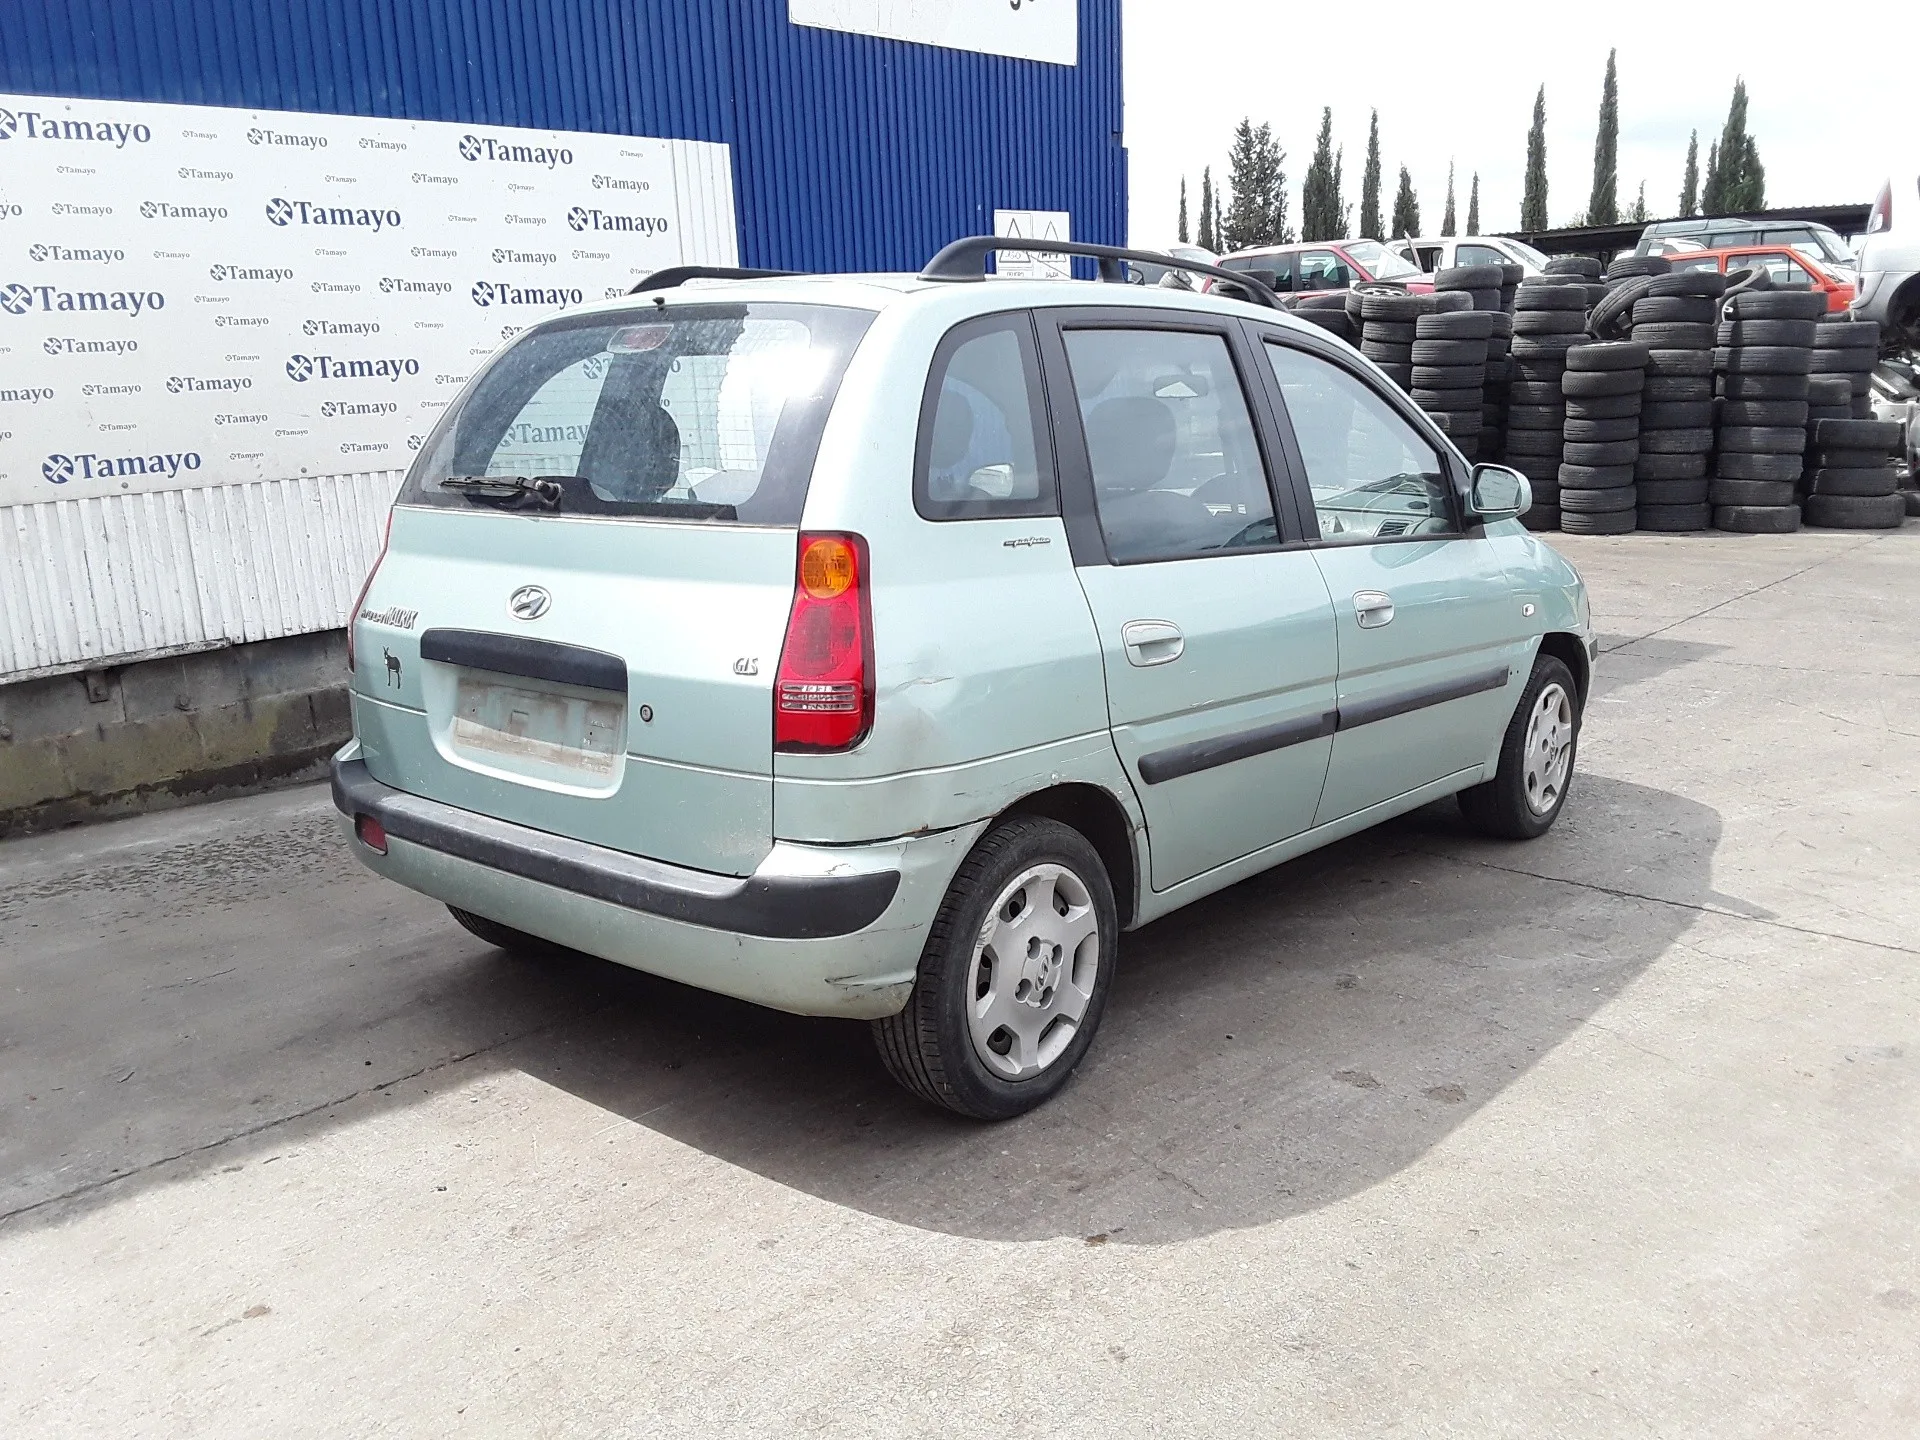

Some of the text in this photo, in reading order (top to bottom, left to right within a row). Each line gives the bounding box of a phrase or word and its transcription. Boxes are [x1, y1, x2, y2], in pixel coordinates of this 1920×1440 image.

[18, 112, 150, 149] Tamayo
[189, 131, 217, 140] Tamayo
[263, 130, 327, 150] Tamayo
[368, 140, 406, 152] Tamayo
[482, 138, 572, 169] Tamayo
[189, 169, 233, 180] Tamayo
[421, 174, 458, 186] Tamayo
[603, 177, 649, 193] Tamayo
[64, 205, 112, 217] Tamayo
[158, 203, 227, 222] Tamayo
[294, 201, 400, 233] Tamayo
[513, 215, 546, 227] Tamayo
[589, 209, 667, 238] Tamayo
[49, 246, 124, 264] Tamayo
[421, 249, 457, 260] Tamayo
[505, 249, 556, 267] Tamayo
[580, 252, 609, 261] Tamayo
[227, 265, 293, 283] Tamayo
[321, 283, 360, 295] Tamayo
[394, 278, 451, 296] Tamayo
[34, 286, 164, 318] Tamayo
[202, 296, 229, 304] Tamayo
[495, 283, 582, 310] Tamayo
[226, 317, 269, 329] Tamayo
[318, 320, 379, 337] Tamayo
[62, 338, 137, 356] Tamayo
[314, 355, 419, 383] Tamayo
[183, 376, 252, 393] Tamayo
[444, 374, 469, 384] Tama
[0, 386, 54, 404] mayo
[94, 384, 141, 395] Tamayo
[337, 401, 397, 417] Tamayo
[107, 424, 136, 432] Tamayo
[225, 414, 268, 426] Tamayo
[516, 423, 589, 445] Tamay
[237, 452, 264, 460] Tamayo
[350, 443, 389, 454] Tamayo
[75, 450, 201, 480] Tamayo
